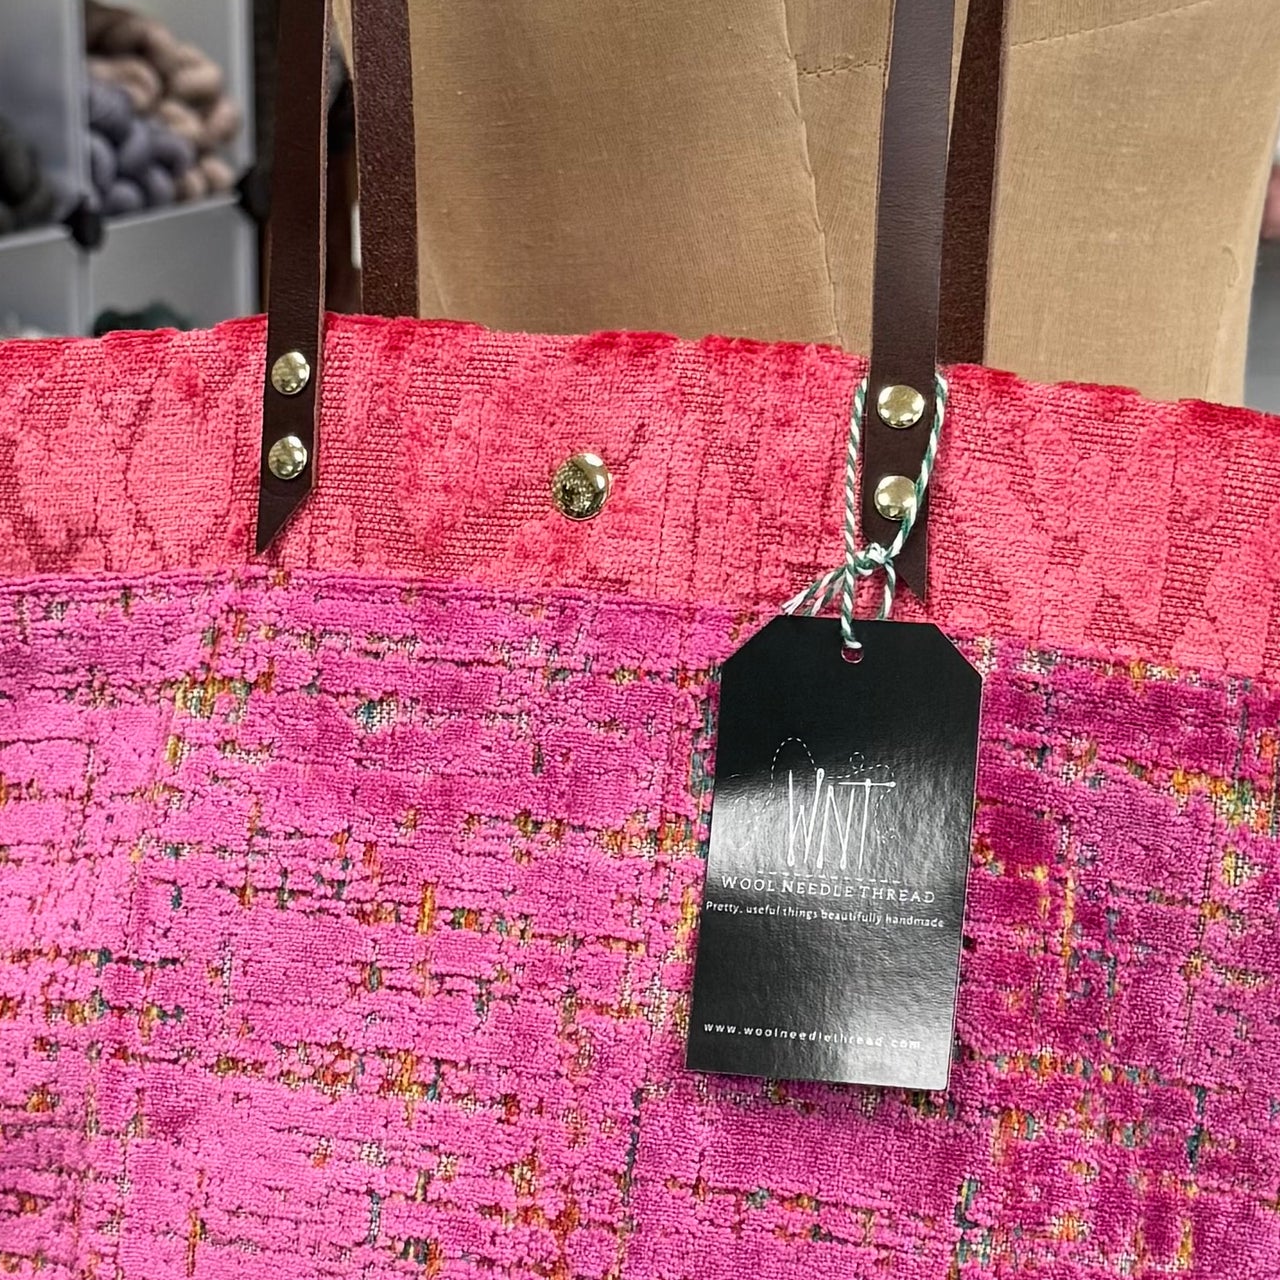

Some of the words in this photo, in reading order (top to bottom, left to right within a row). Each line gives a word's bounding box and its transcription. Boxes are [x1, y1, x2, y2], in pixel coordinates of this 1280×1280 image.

[786, 767, 897, 871] WNT
[721, 875, 776, 893] WOOL
[781, 879, 855, 898] NEEDLE
[858, 885, 936, 904] THREAD
[745, 904, 781, 916] useful
[782, 906, 819, 921] things
[820, 909, 882, 926] beautifully
[885, 913, 945, 928] handmade
[704, 1023, 922, 1049] www.woolneedlethreadcom
